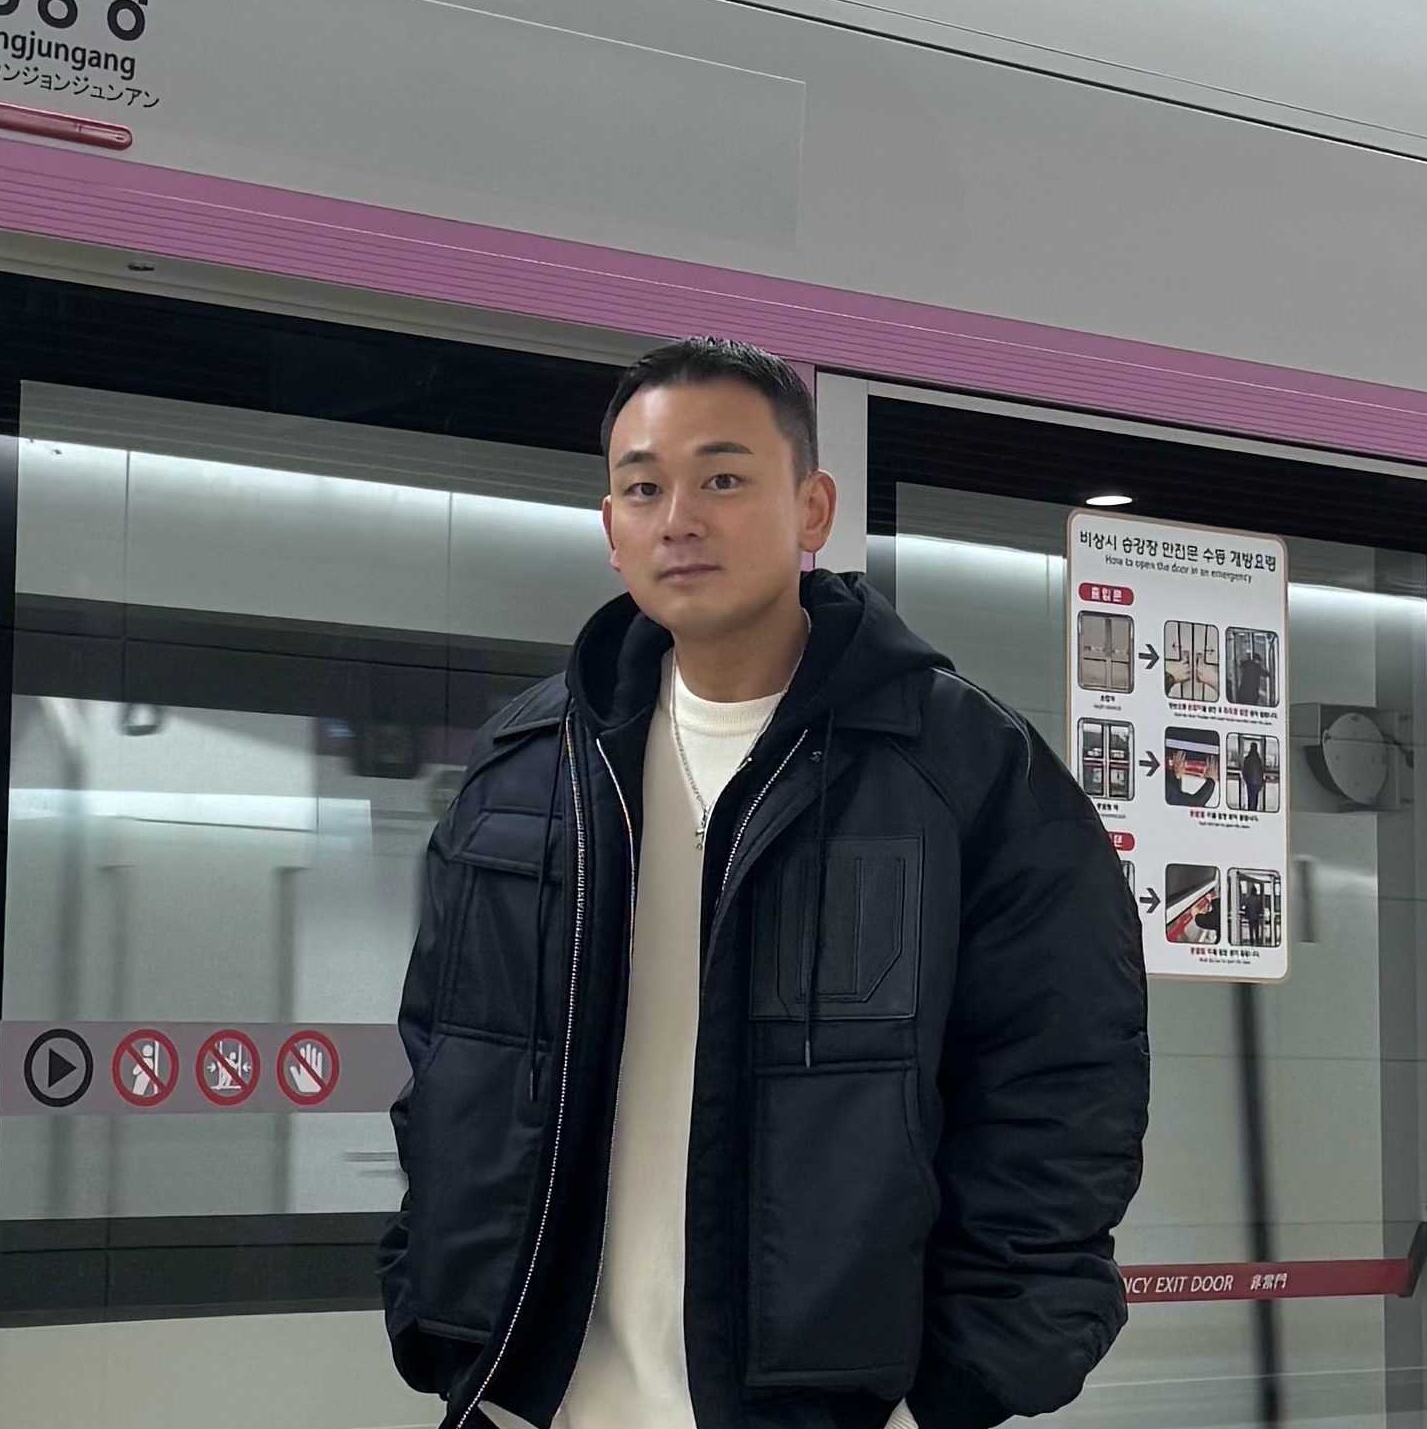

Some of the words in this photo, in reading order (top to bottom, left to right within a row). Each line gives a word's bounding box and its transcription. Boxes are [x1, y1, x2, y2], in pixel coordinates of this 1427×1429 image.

[1080, 530, 1117, 551] 비상시
[1155, 1275, 1188, 1293] EXIT
[1190, 1274, 1234, 1292] DOOR
